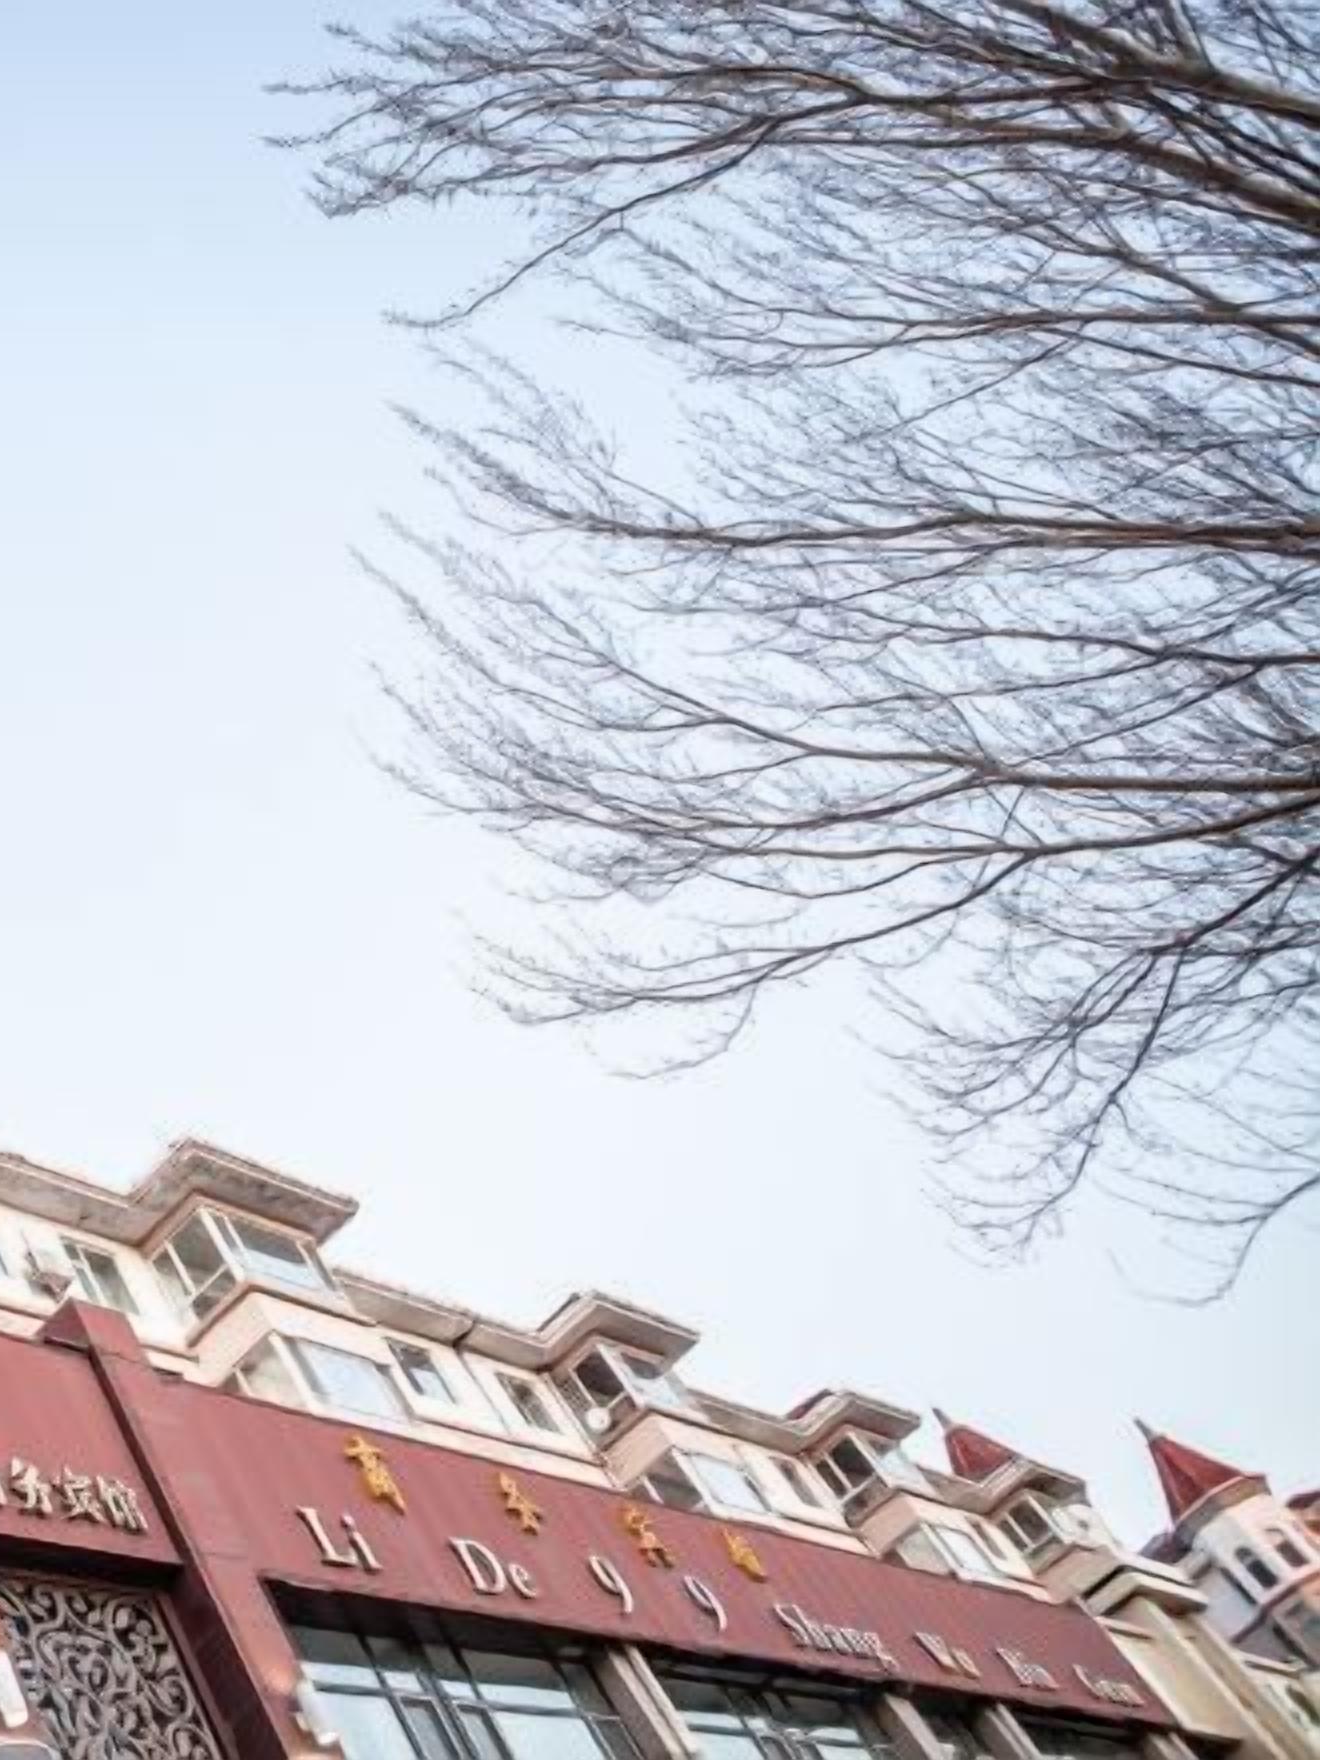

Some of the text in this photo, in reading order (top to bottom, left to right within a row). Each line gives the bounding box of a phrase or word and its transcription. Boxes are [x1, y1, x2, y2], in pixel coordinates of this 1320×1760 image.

[294, 1505, 383, 1574] Li
[447, 1536, 538, 1599] De
[773, 1603, 901, 1674] Shang
